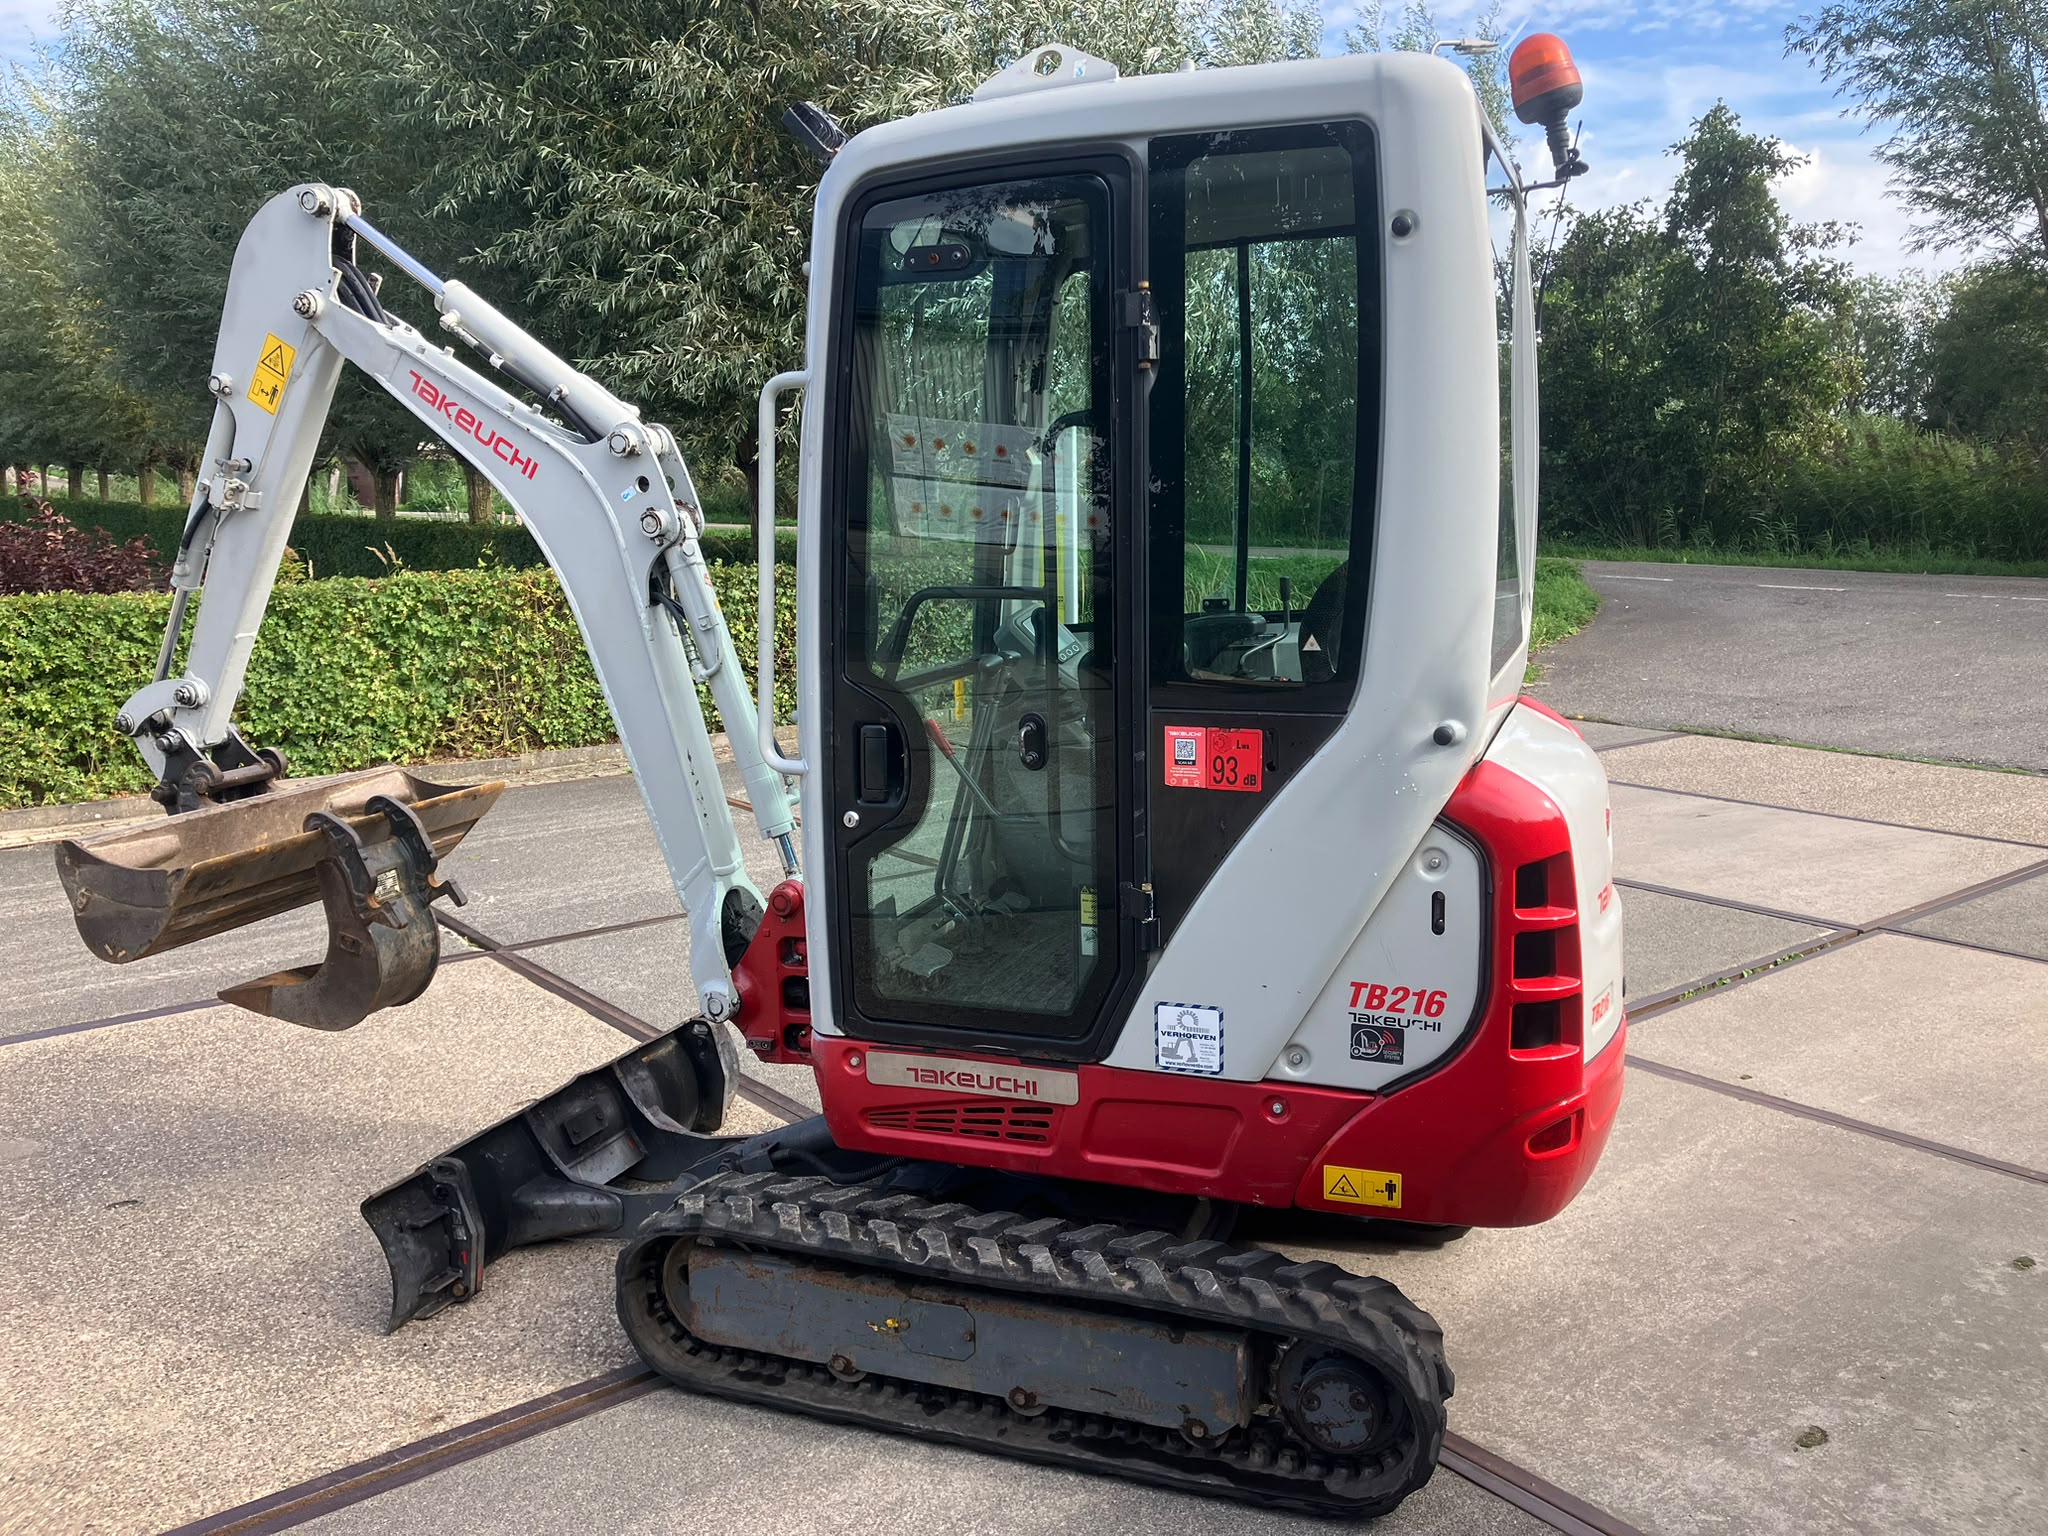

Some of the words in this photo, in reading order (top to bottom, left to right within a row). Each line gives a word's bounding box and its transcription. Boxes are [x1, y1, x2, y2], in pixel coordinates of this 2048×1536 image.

[409, 369, 539, 480] TAKEUCHI
[1212, 755, 1238, 786] 93
[1243, 773, 1257, 786] dB
[1349, 981, 1448, 1018] TB216
[1160, 1030, 1217, 1041] VERHOEVEN
[906, 1067, 1038, 1096] TAKEUCHI
